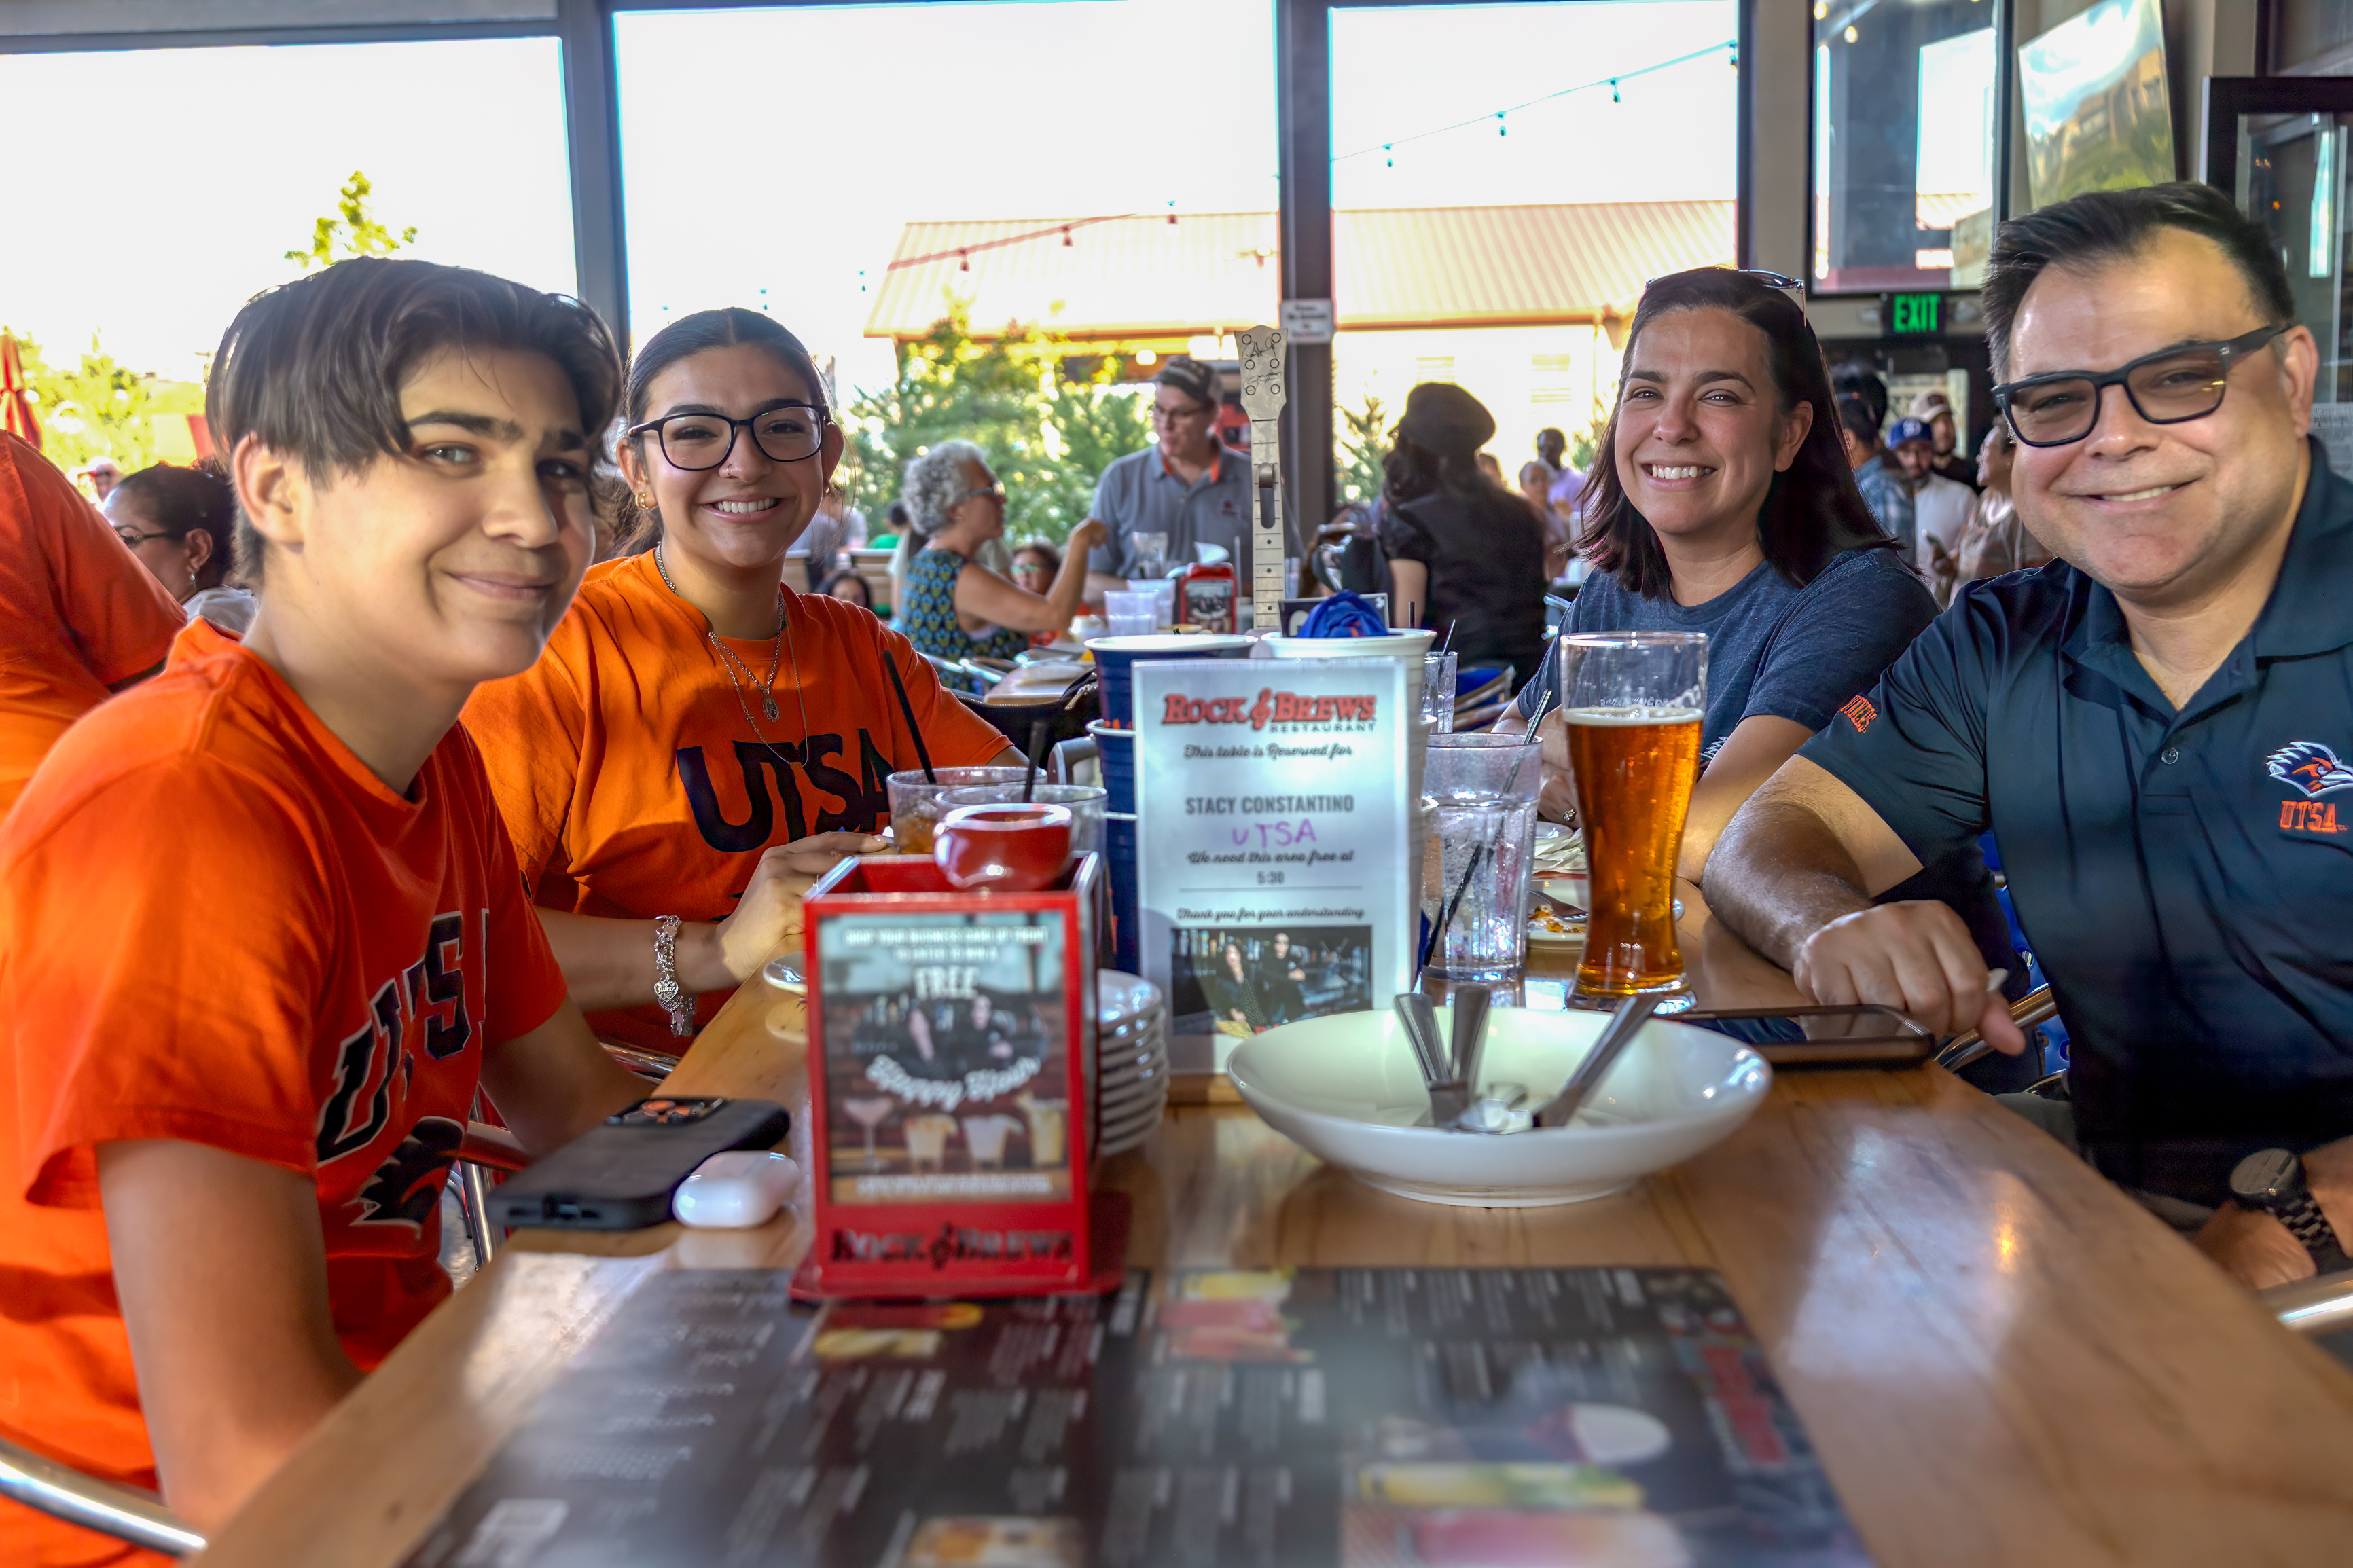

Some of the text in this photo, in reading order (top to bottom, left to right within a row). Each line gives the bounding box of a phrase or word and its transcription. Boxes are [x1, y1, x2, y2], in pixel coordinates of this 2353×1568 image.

[1893, 293, 1941, 333] EXIT
[1269, 723, 1376, 733] RESTAURANT
[1184, 742, 1353, 761] This table is Reserved for
[676, 728, 895, 853] UTSA
[1185, 795, 1354, 815] STACY CONSTANTINO
[2280, 801, 2337, 833] UTSA
[1187, 850, 1210, 864] We
[1212, 850, 1244, 864] need
[1248, 850, 1273, 863] this
[1275, 850, 1306, 863] area
[1307, 849, 1337, 866] free
[1176, 907, 1365, 922] Thank you for your understanding
[915, 965, 980, 999] FREE
